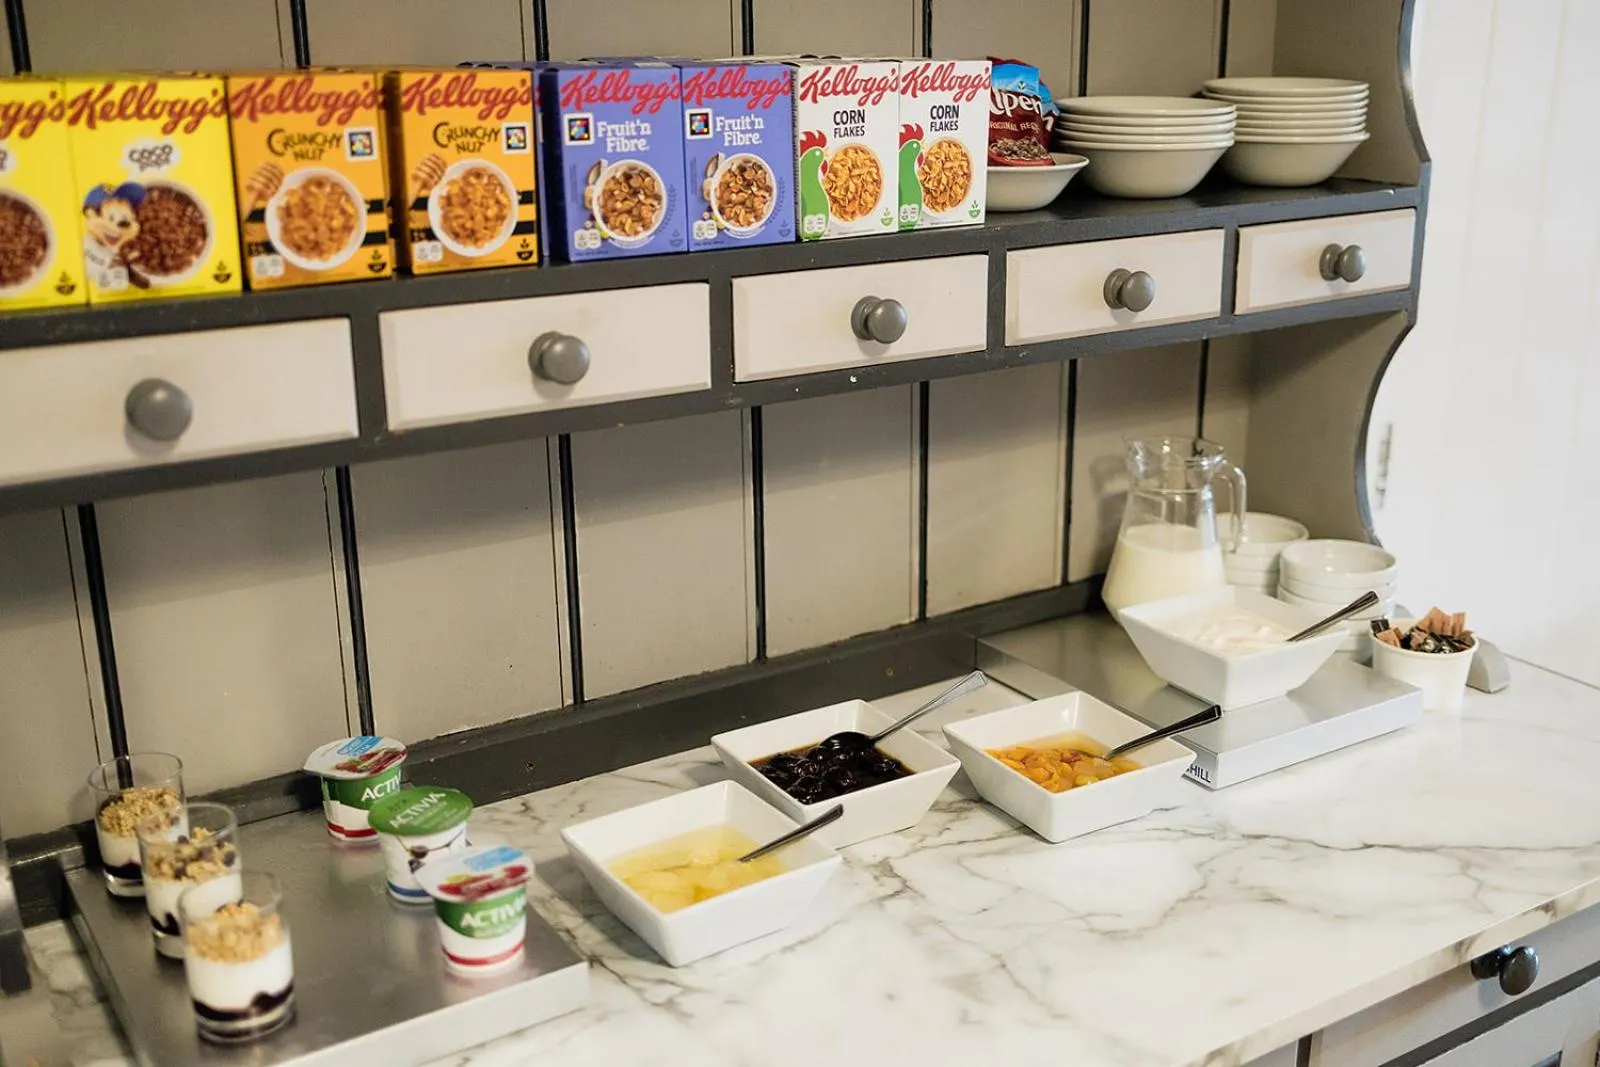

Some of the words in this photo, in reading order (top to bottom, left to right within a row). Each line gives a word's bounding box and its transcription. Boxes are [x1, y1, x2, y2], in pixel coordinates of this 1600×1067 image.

[560, 68, 681, 115] Kellogg's
[684, 64, 792, 110] Kellogg's
[799, 64, 899, 107] Kellogg's
[901, 61, 991, 103] Kellogg's
[231, 75, 378, 127] Kellogg's
[401, 72, 531, 121] Kellogg's
[66, 80, 226, 135] Kellogg's
[833, 109, 866, 126] CORN
[930, 104, 960, 120] CORN
[597, 119, 652, 138] Fruit'n
[716, 113, 764, 132] Fruit'n
[833, 125, 866, 139] FLAKES
[930, 120, 959, 132] FLAKES
[294, 147, 324, 162] NUT
[456, 141, 484, 154] NUT
[1186, 763, 1211, 784] HILL
